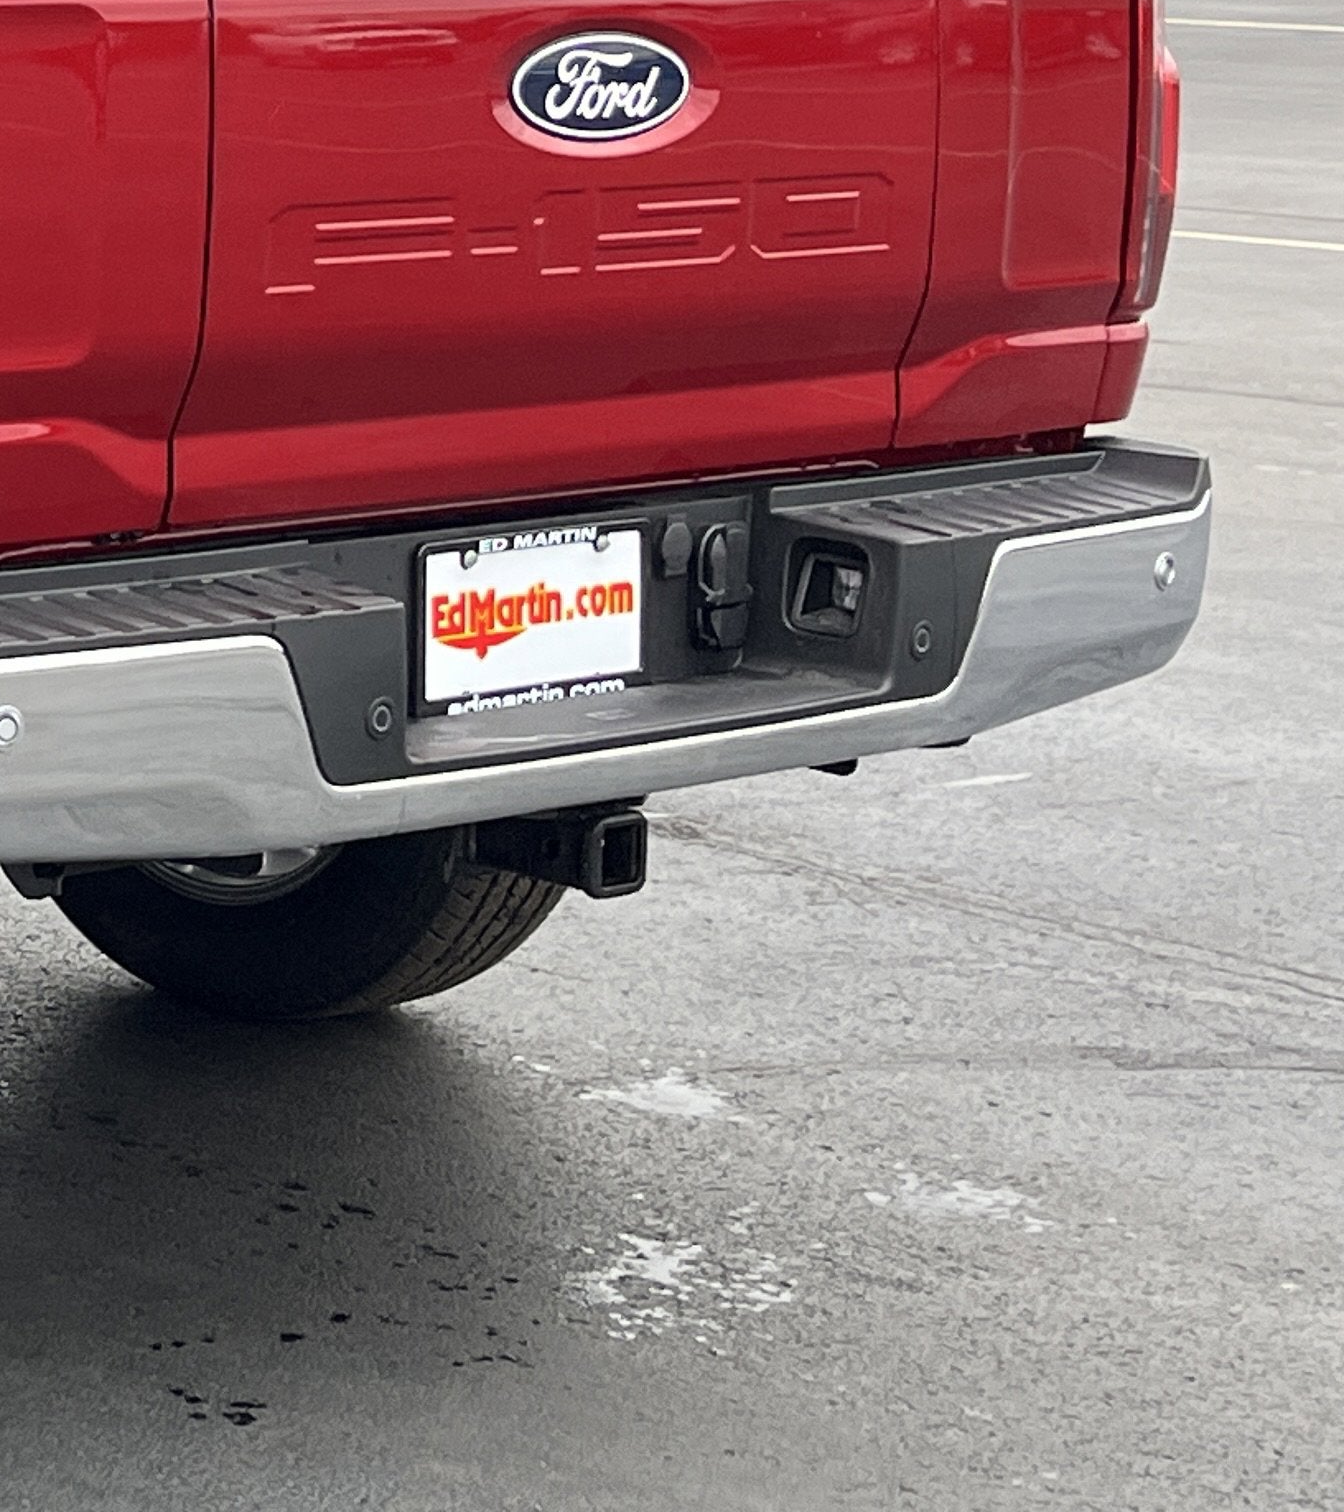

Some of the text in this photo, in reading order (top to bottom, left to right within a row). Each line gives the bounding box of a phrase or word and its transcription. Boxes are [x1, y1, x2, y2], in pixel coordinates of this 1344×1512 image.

[544, 48, 662, 120] Ford
[264, 172, 895, 294] F-150
[478, 526, 597, 553] ED MARTIN
[431, 582, 634, 639] EdMartin.com
[447, 678, 625, 716] edmartincom
